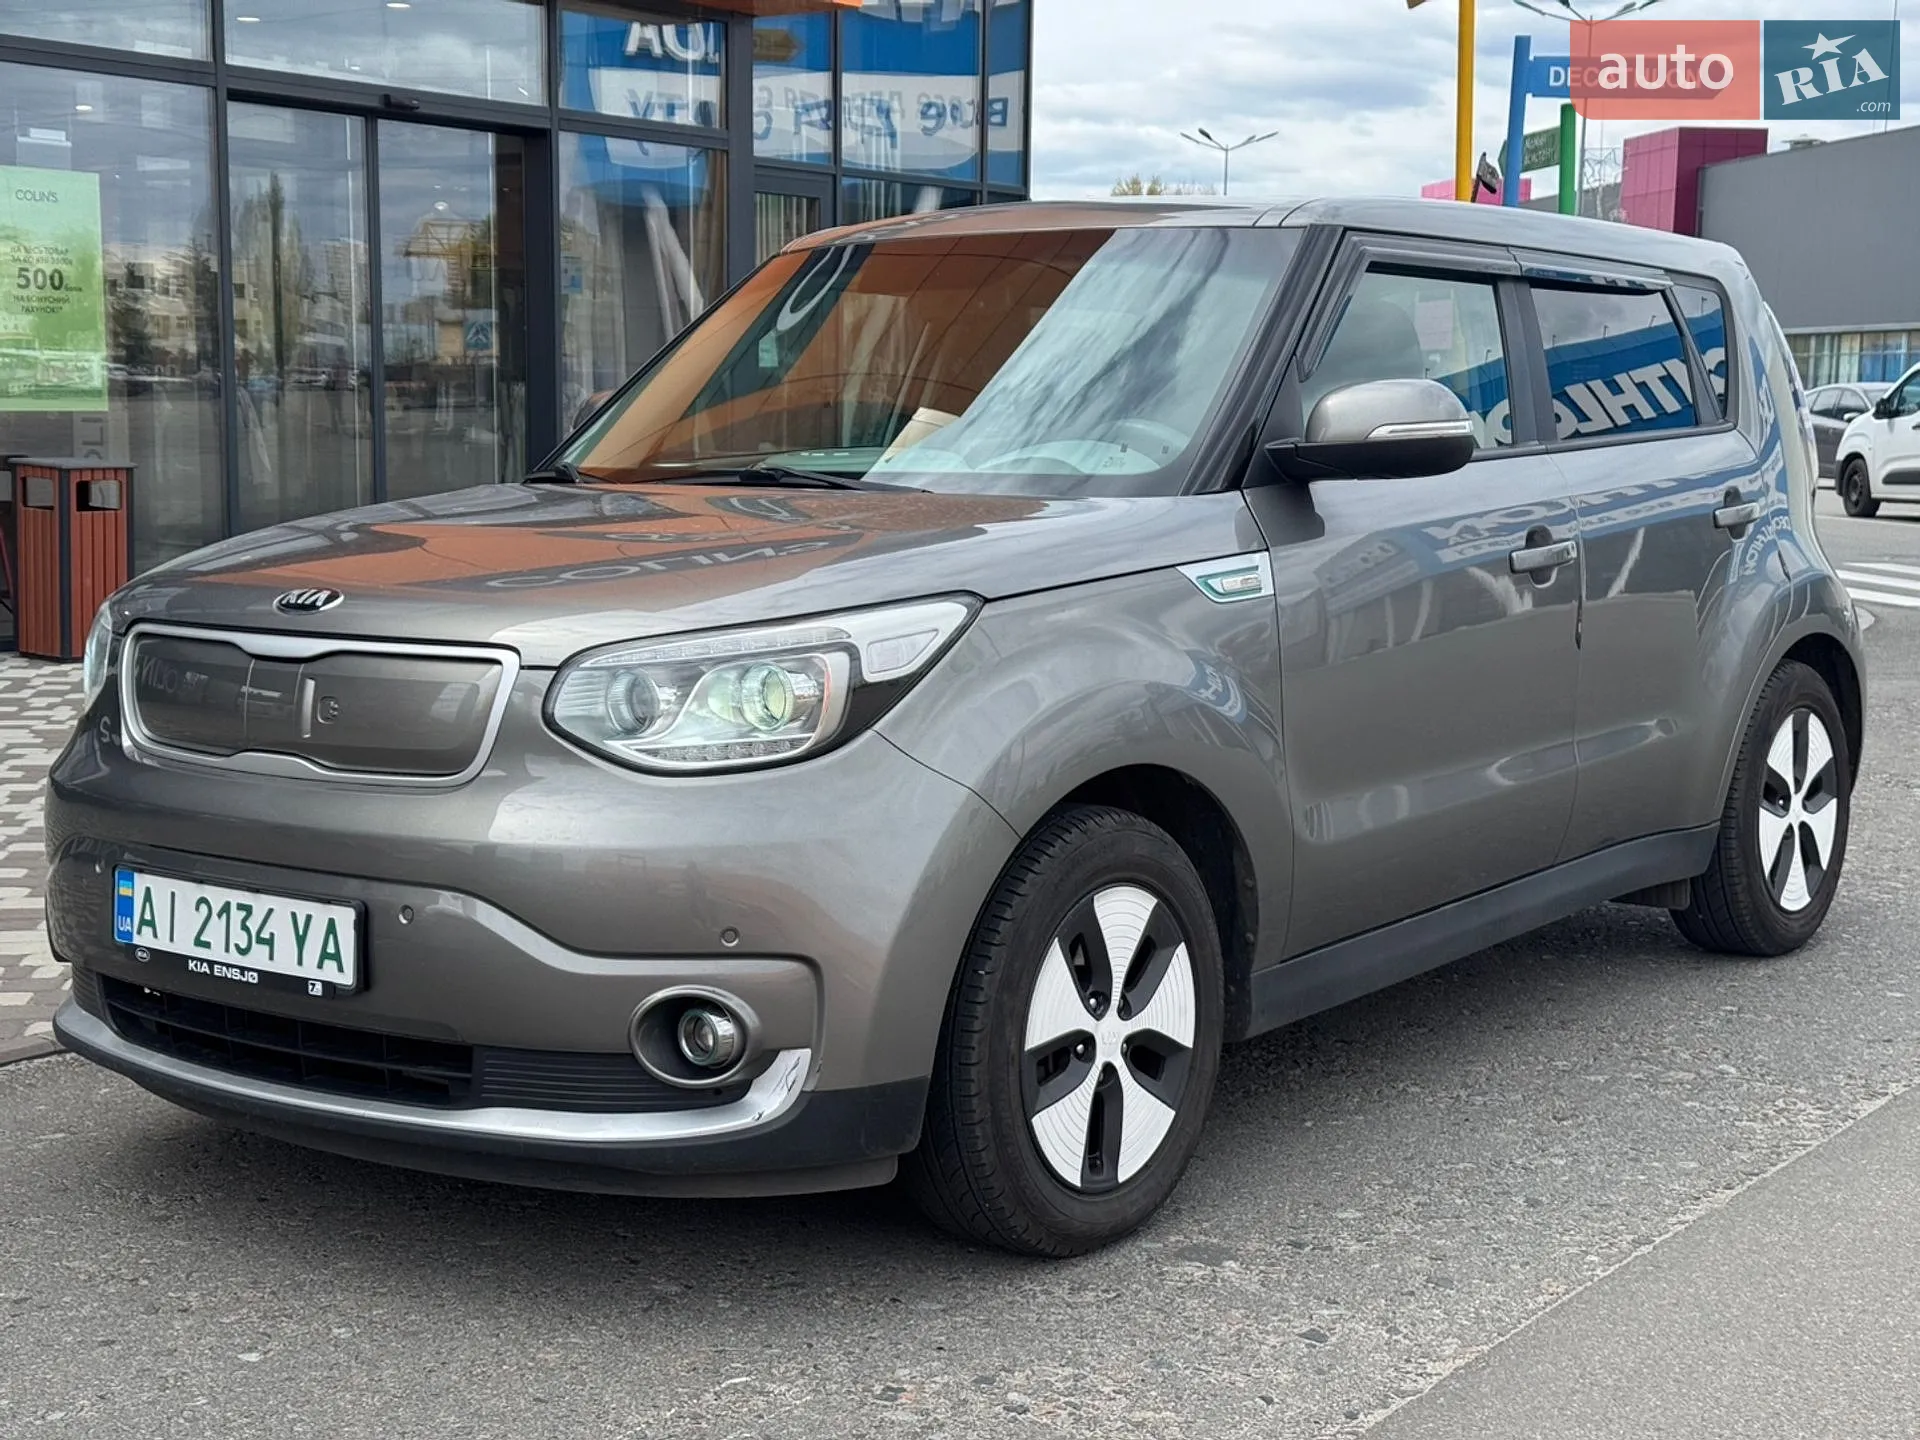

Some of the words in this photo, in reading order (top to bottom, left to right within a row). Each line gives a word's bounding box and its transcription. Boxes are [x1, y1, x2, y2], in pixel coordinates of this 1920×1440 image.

[16, 267, 64, 292] 500
[281, 589, 332, 606] KIA
[118, 915, 132, 932] UA
[135, 886, 176, 943] AI
[193, 896, 275, 961] 2134
[290, 911, 344, 973] YA
[188, 960, 210, 975] KIA
[214, 966, 259, 984] ENSJØ
